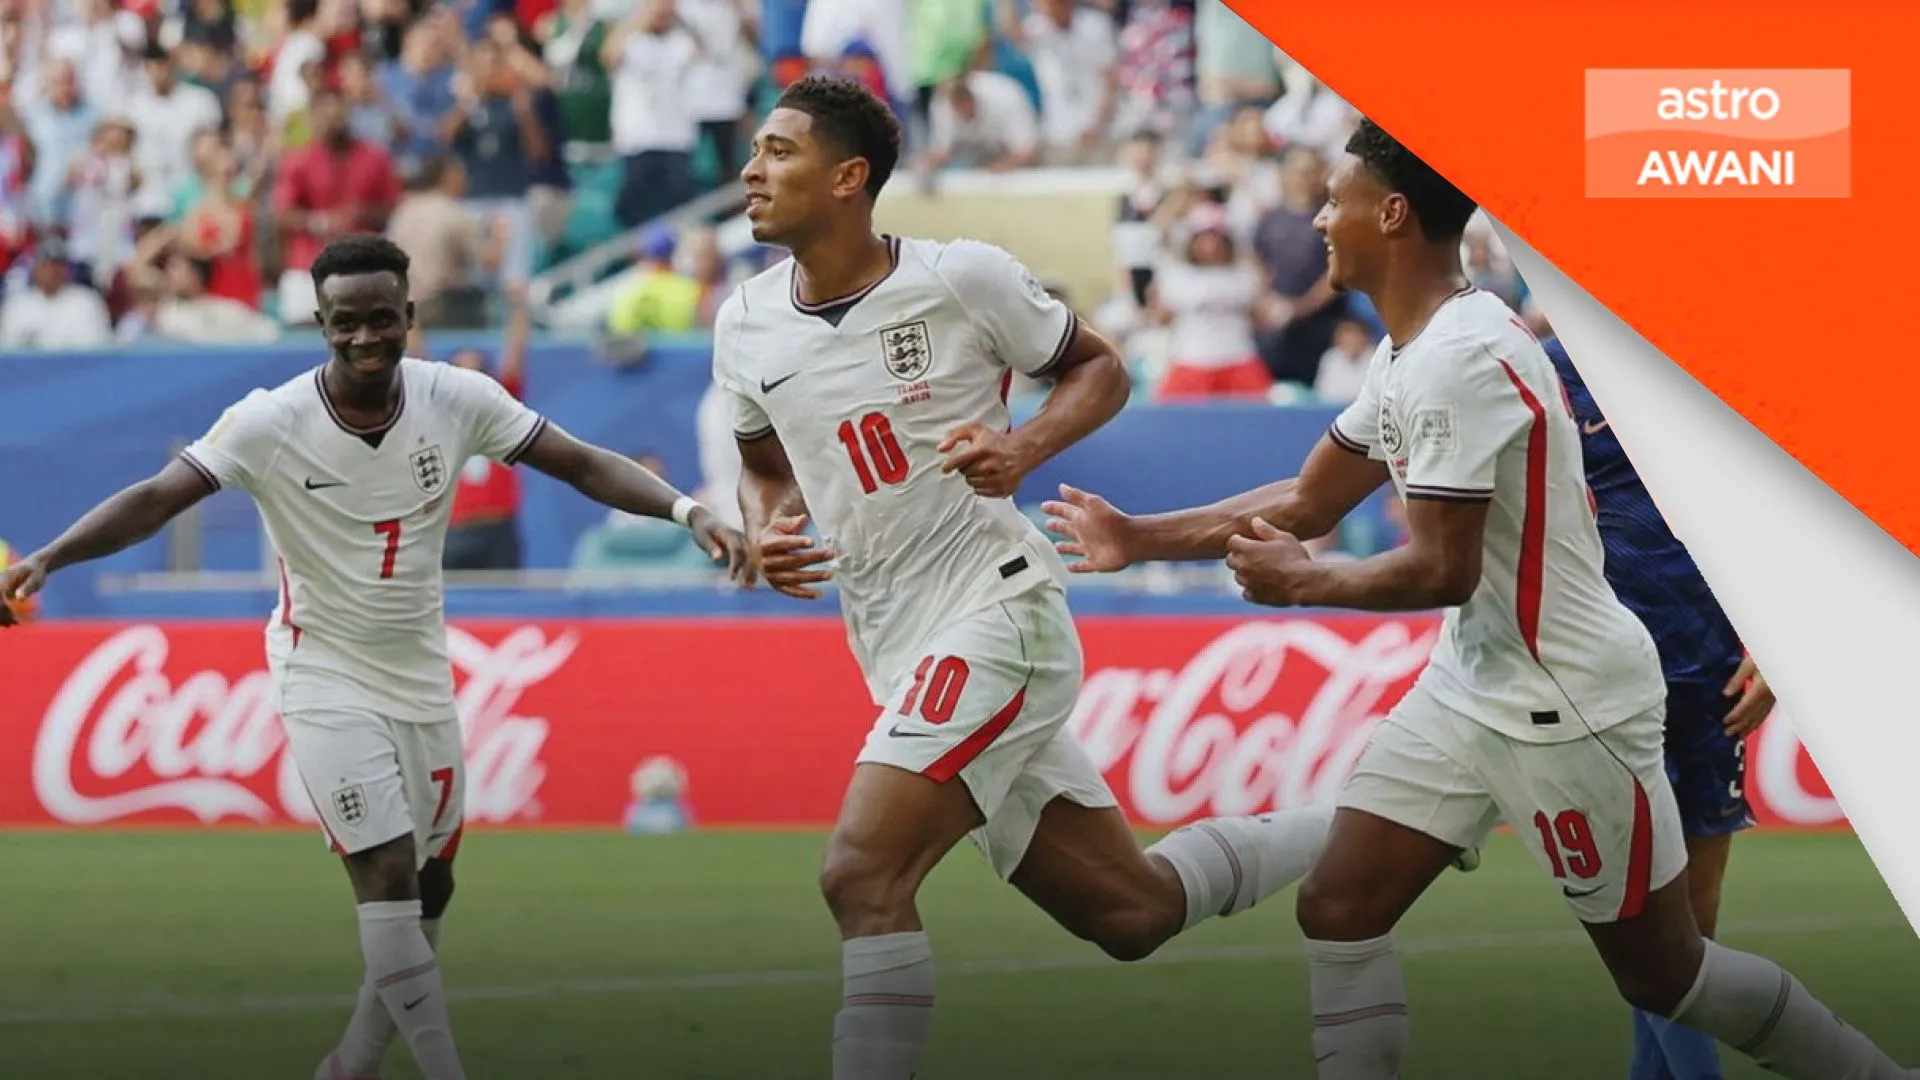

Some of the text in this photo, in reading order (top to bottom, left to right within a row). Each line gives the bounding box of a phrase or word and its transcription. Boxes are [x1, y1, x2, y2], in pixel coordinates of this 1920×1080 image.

[837, 411, 910, 494] 10
[373, 518, 401, 579] 7
[898, 655, 970, 725] 10
[430, 766, 453, 829] 7
[1533, 808, 1603, 879] 19
